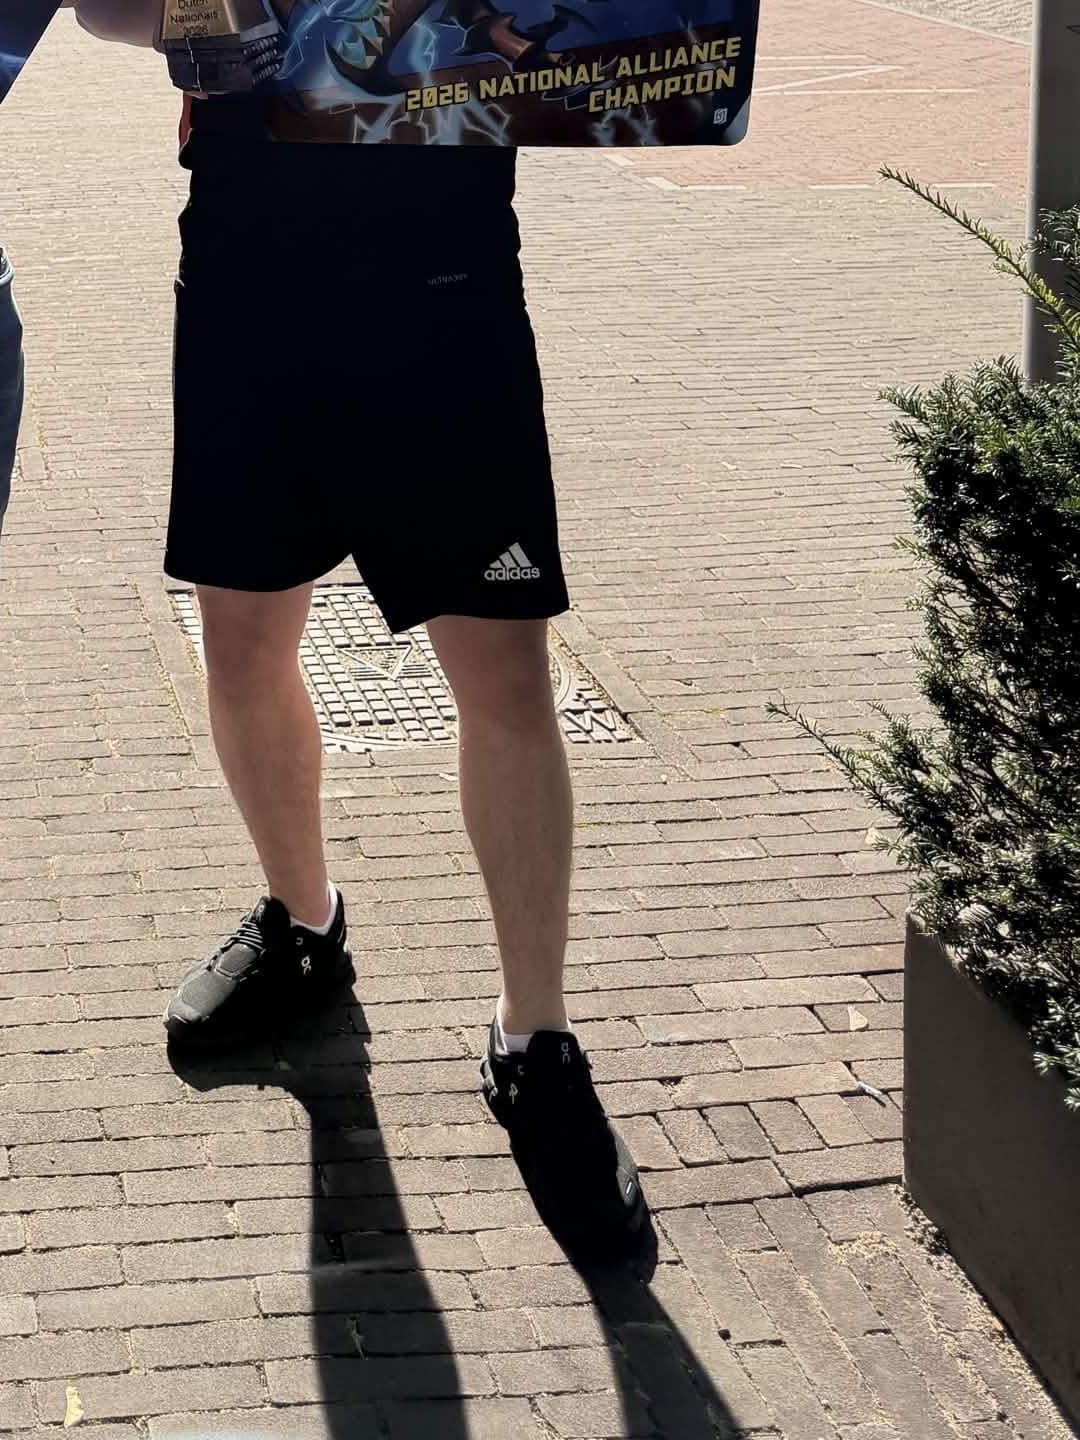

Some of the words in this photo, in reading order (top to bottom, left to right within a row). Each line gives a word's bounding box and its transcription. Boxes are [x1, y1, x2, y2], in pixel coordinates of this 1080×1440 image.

[407, 82, 469, 111] 2026
[479, 61, 606, 100] NATIONAL
[616, 36, 743, 79] ALLIANCE
[588, 66, 737, 113] CHAMPION
[483, 566, 541, 582] adidas
